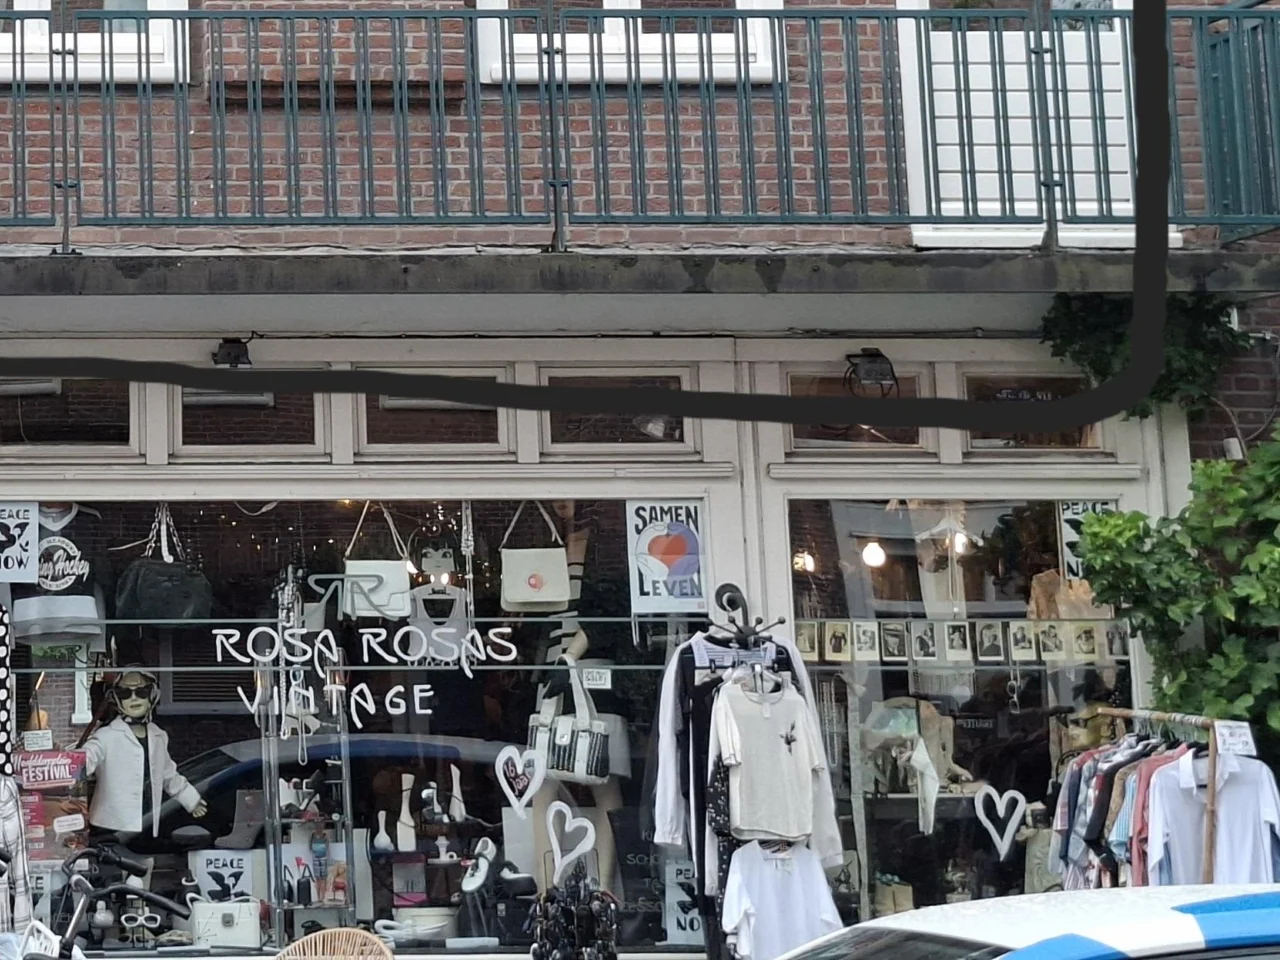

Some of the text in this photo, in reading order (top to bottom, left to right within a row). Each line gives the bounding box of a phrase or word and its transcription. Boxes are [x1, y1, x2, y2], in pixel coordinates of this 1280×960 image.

[634, 505, 700, 535] SAMEN
[52, 548, 90, 582] Hockey
[637, 566, 704, 598] LEVEN
[212, 626, 518, 678] ROSA ROSAS
[236, 682, 435, 729] VINTAGE
[22, 765, 73, 783] FESTIVAL
[205, 858, 244, 869] PEACE
[676, 916, 701, 932] NO
